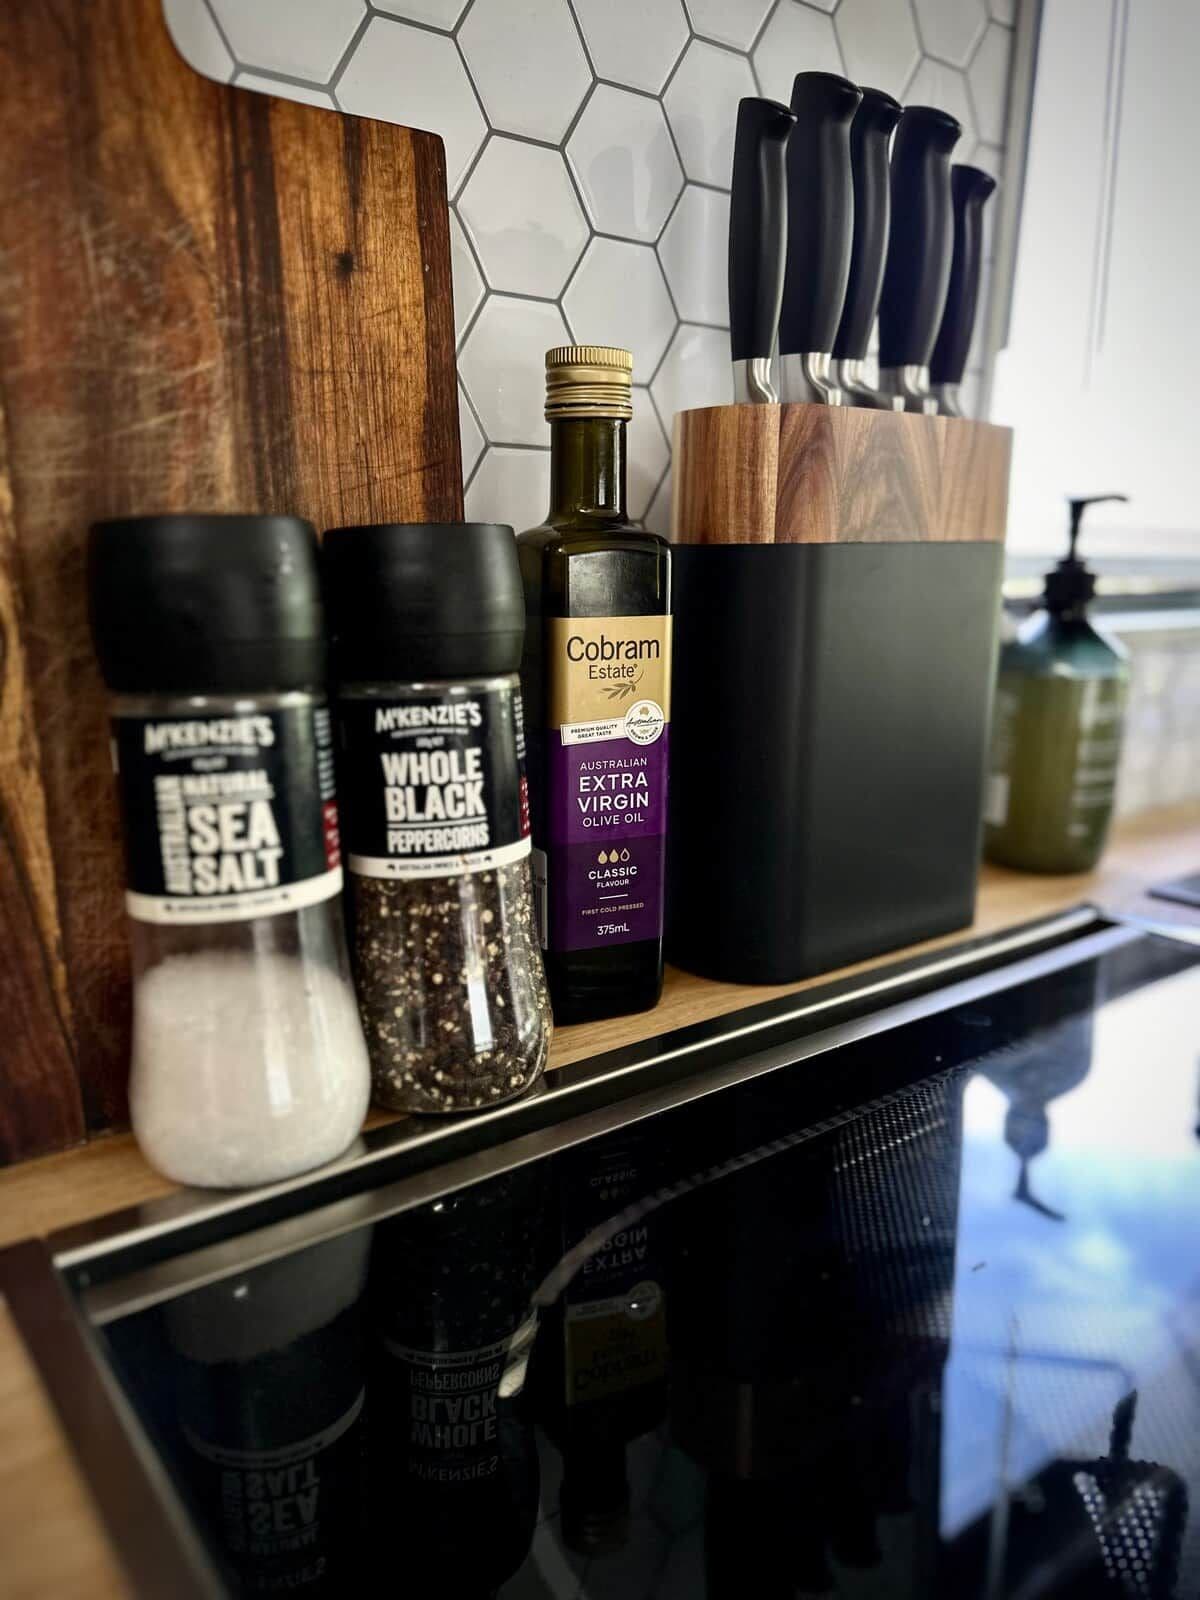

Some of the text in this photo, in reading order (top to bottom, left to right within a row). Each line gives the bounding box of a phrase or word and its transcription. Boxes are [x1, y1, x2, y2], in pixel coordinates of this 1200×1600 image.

[567, 635, 660, 661] Cobram
[381, 748, 483, 785] WHOLE
[580, 758, 647, 771] AUSTRALIAN
[579, 772, 648, 792] EXTRA
[384, 781, 486, 822] BLACK
[577, 792, 649, 813] VIRGIN
[188, 799, 281, 853] SEA
[582, 812, 645, 828] OLIVE OIL
[387, 823, 489, 853] PEPPERCORNS
[192, 848, 283, 894] SALT
[588, 866, 637, 880] CLASSIC
[596, 879, 629, 888] FLAVOUR
[582, 908, 599, 916] FIRST
[618, 902, 644, 911] PRESSED
[597, 922, 630, 936] 375mL
